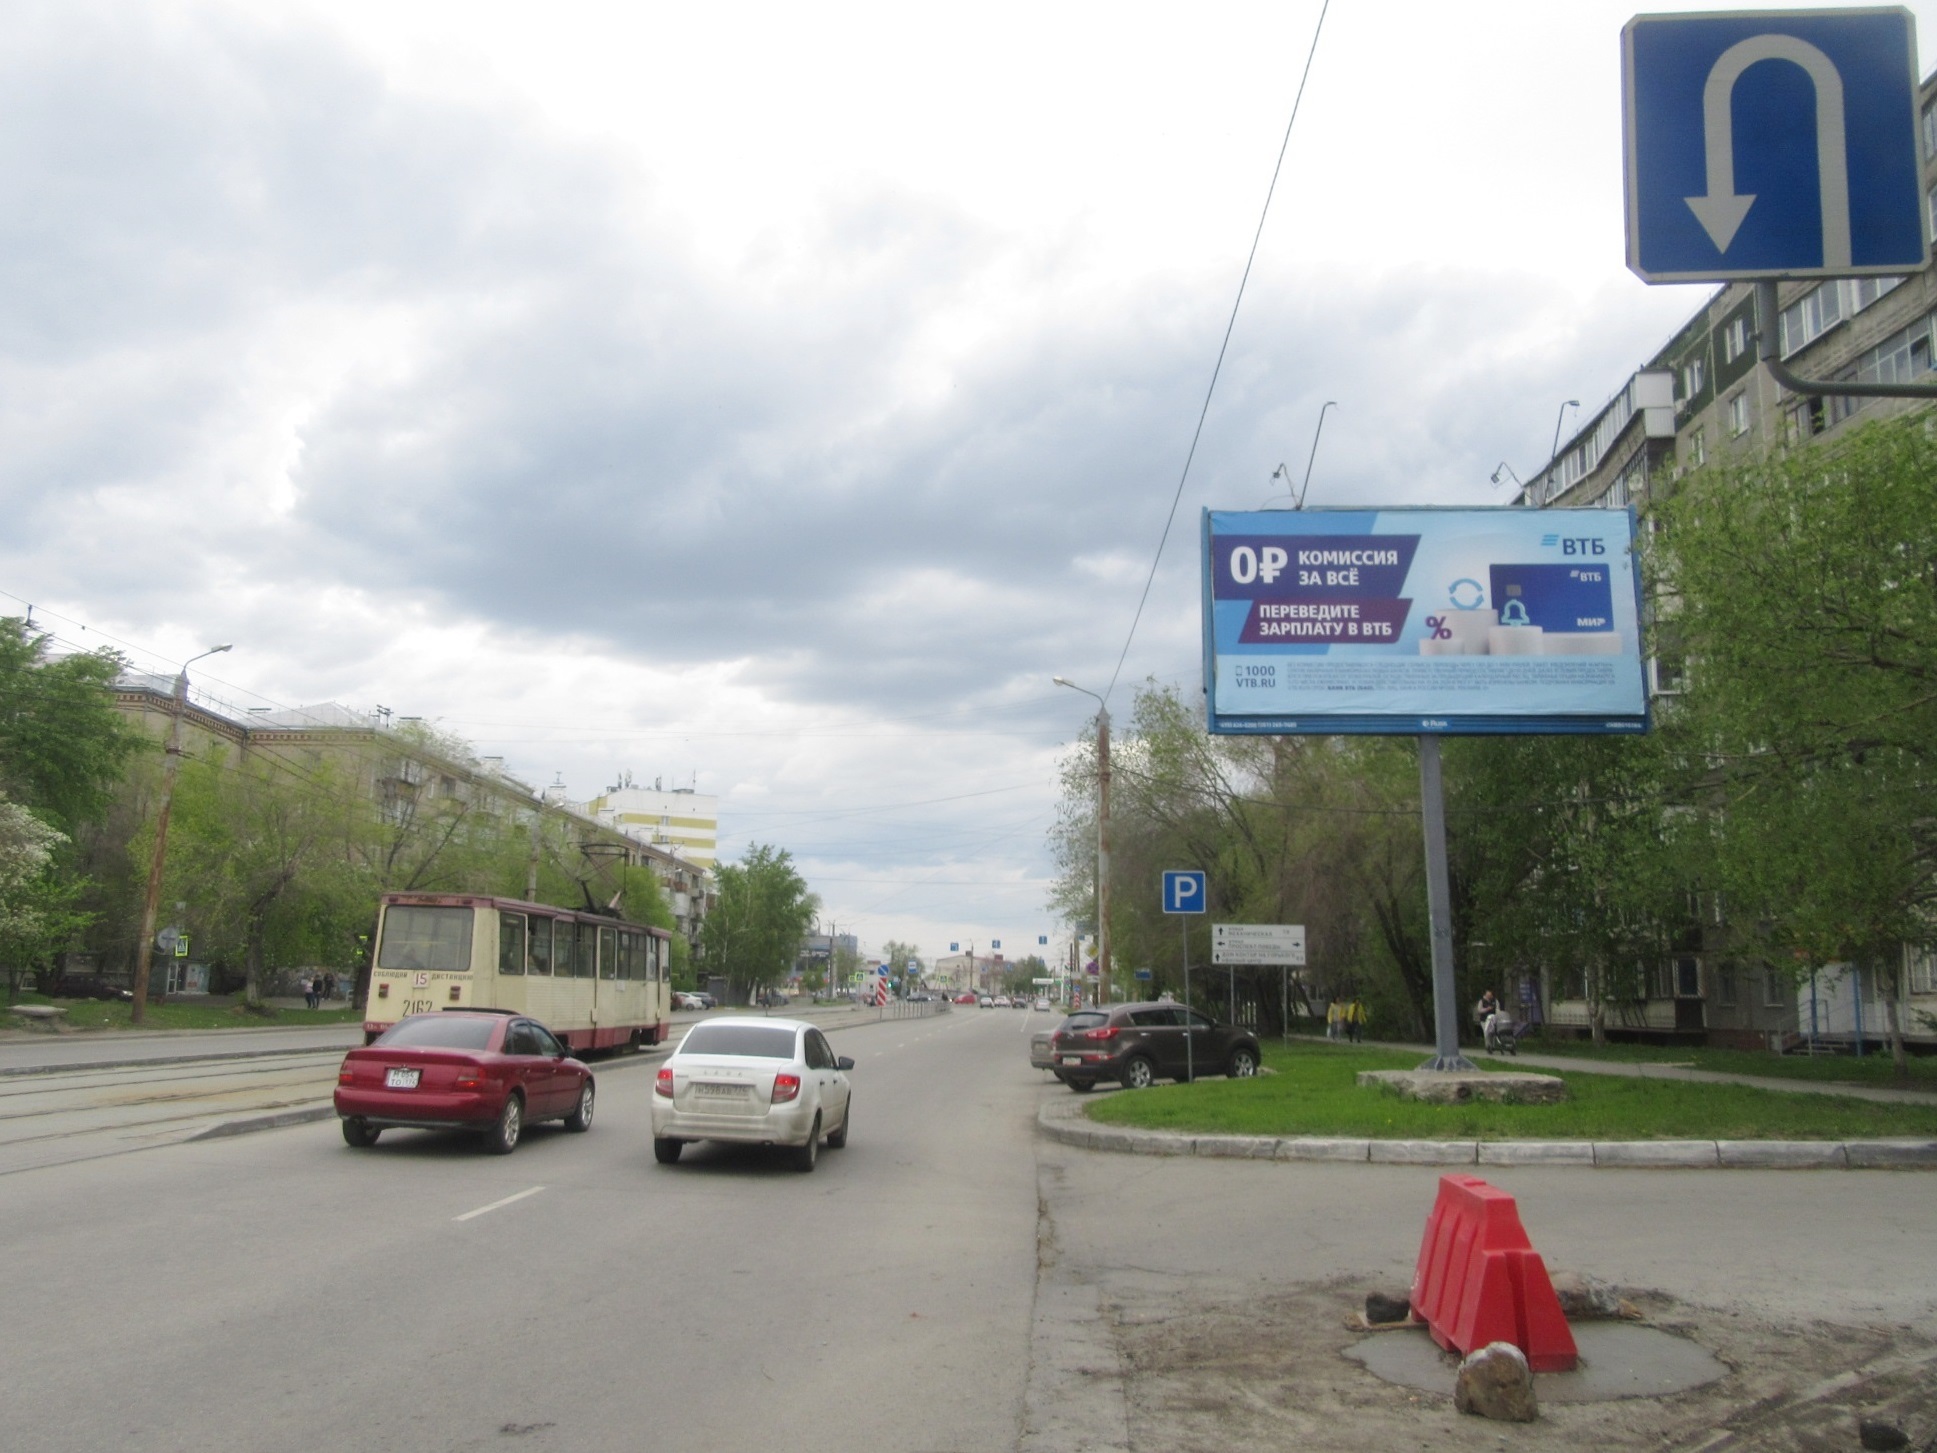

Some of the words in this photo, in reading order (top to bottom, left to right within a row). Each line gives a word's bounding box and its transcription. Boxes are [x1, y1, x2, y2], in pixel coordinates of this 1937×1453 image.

[1563, 538, 1606, 555] ВТБ
[1298, 550, 1398, 566] КОМИССИЯ
[1298, 571, 1322, 585] ЗА
[1326, 567, 1359, 586] ВСЁ
[1580, 572, 1602, 582] ВТБ
[1259, 605, 1360, 620] ПЕРЕВЕДИТЕ
[1259, 622, 1343, 636] ЗАРПЛАТУ
[1348, 622, 1358, 635] В
[1362, 622, 1392, 636] ВТБ
[1577, 618, 1606, 627] МИР
[1245, 666, 1276, 677] 1000
[1236, 678, 1276, 688] VTB.RU
[1174, 876, 1198, 908] P
[415, 972, 428, 985] 15
[431, 973, 474, 981] ДИСТАНЦИЮ
